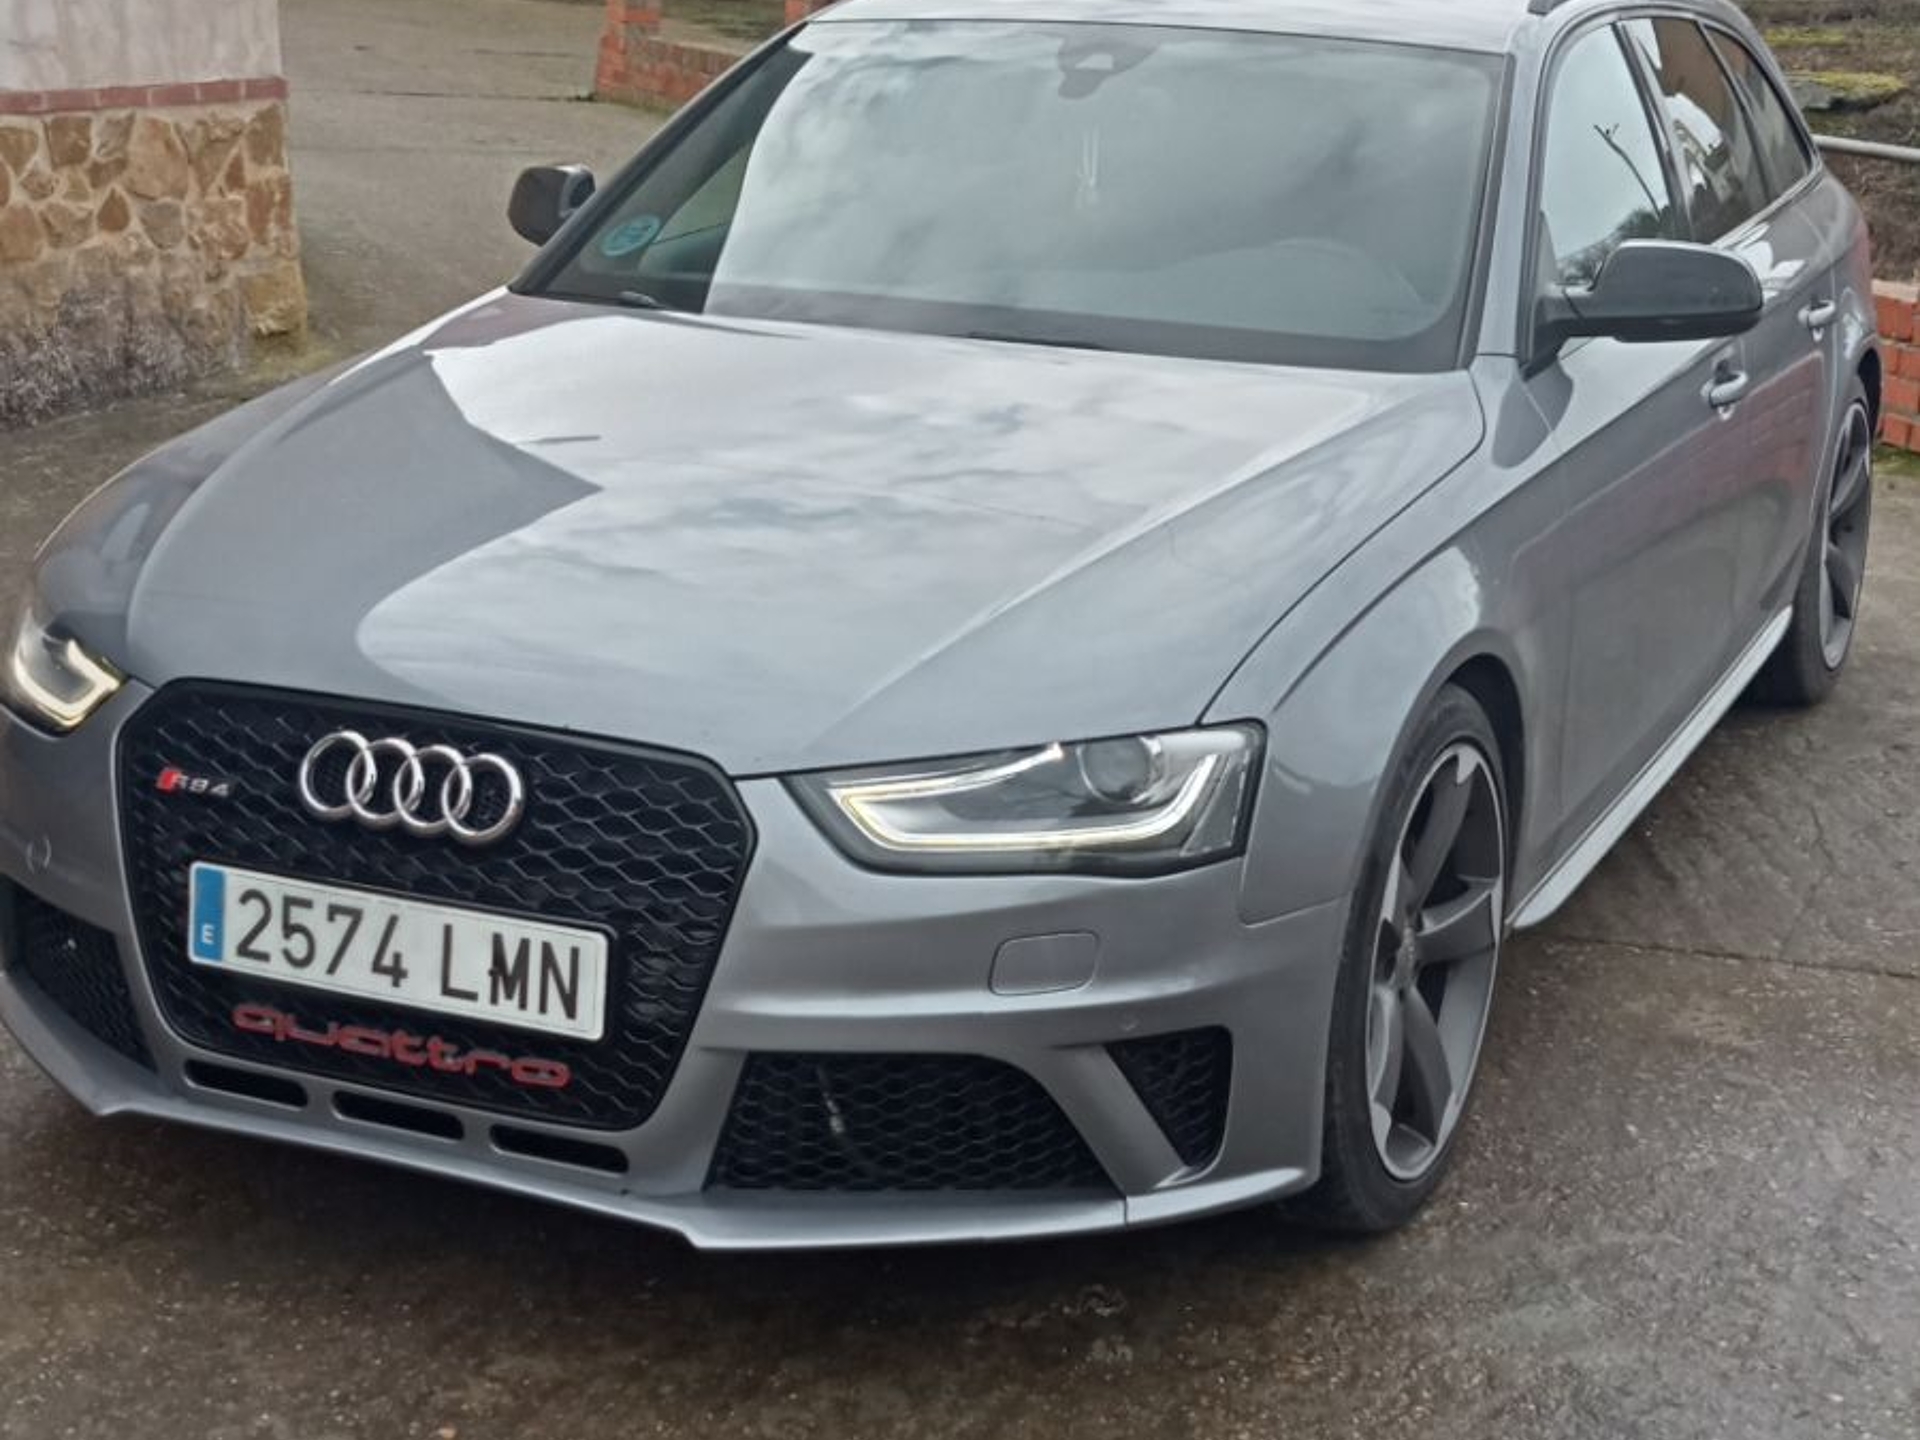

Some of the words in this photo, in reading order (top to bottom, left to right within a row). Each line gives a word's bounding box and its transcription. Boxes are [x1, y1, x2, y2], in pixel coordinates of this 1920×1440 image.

[201, 923, 214, 946] E
[236, 889, 408, 988] 2574
[440, 923, 580, 1021] LMN
[232, 1004, 571, 1088] quattro
